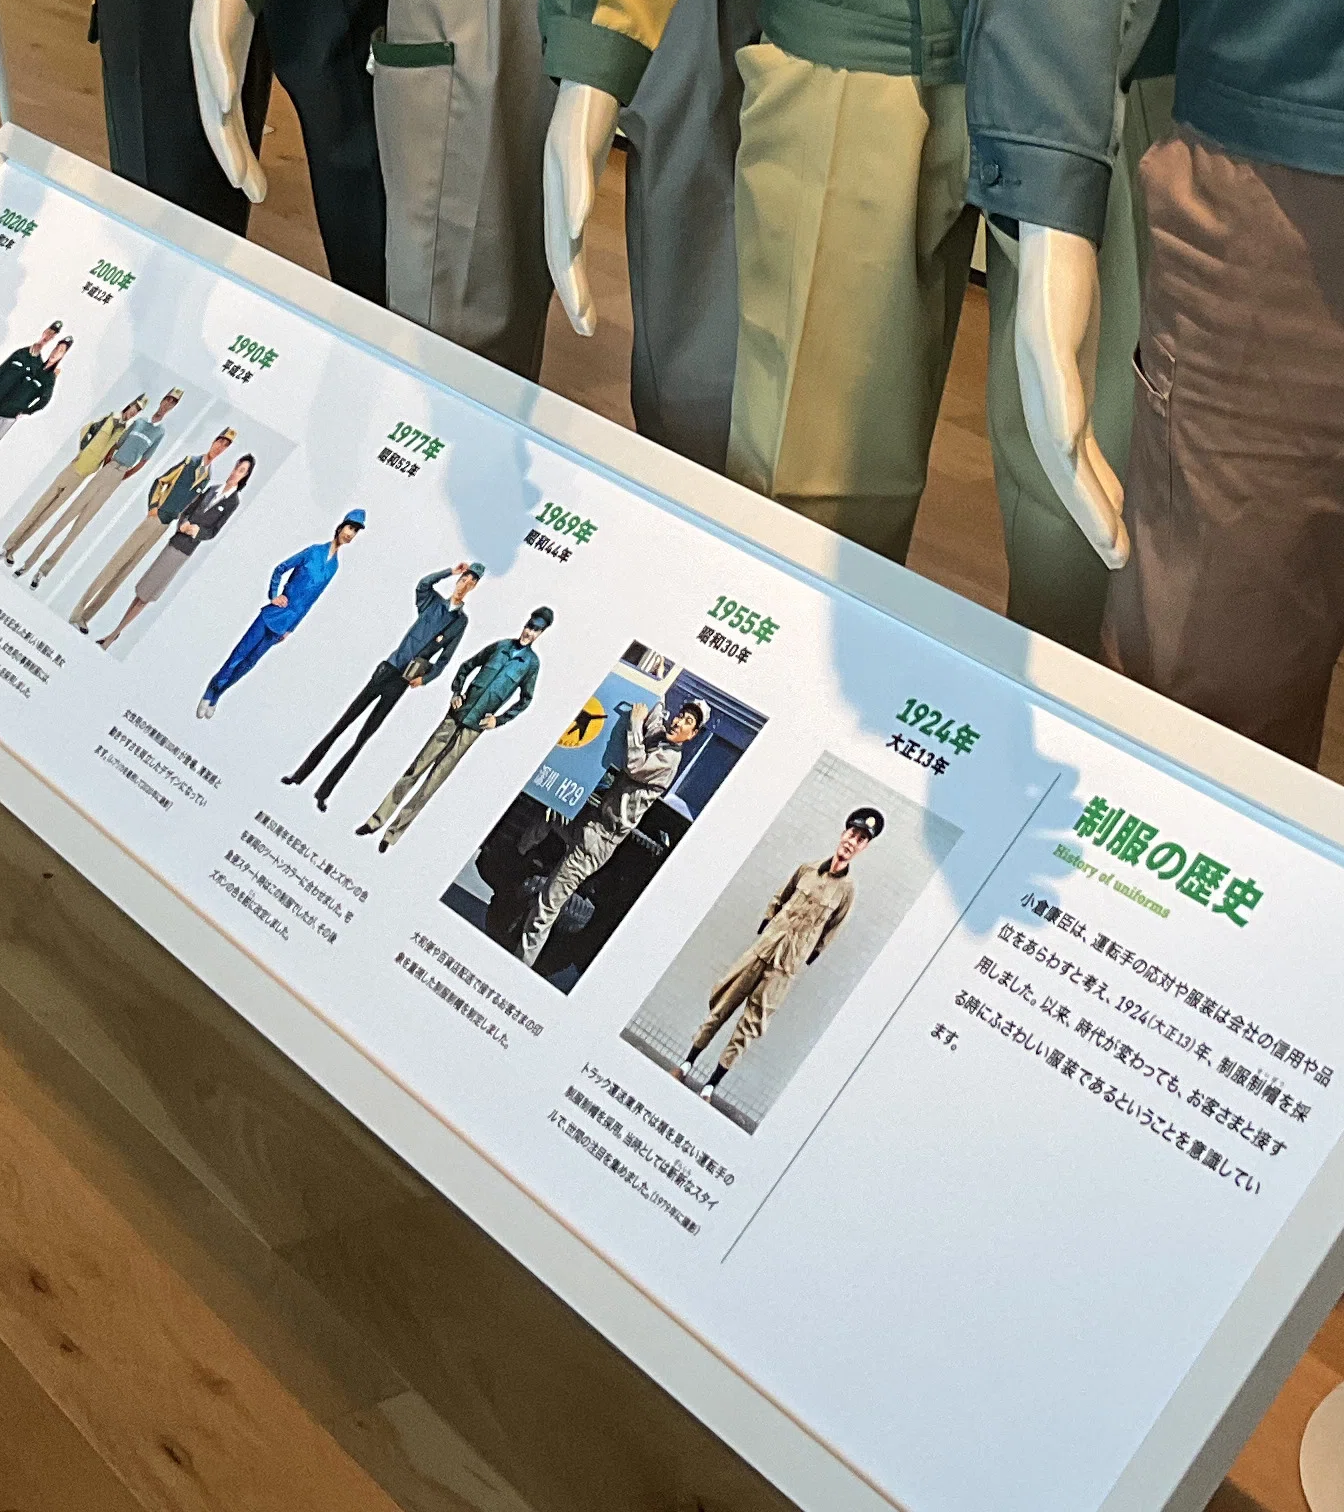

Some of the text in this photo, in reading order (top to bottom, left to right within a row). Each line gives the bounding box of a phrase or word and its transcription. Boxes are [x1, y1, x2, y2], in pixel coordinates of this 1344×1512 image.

[88, 258, 136, 292] 2000年
[227, 334, 279, 370] 1990年
[386, 420, 445, 461] 1977年
[376, 446, 421, 477] 昭和52年
[534, 501, 598, 545] 1969年
[522, 528, 573, 563] 昭和44年
[706, 595, 780, 645] 1955年
[695, 624, 752, 664] 昭和30年
[895, 697, 981, 755] 1924年
[885, 732, 950, 776] 大正13年
[553, 776, 586, 808] H29
[1051, 841, 1171, 919] History of uniforms
[1071, 794, 1264, 928] 制服の歴史
[930, 1022, 959, 1051] ます。
